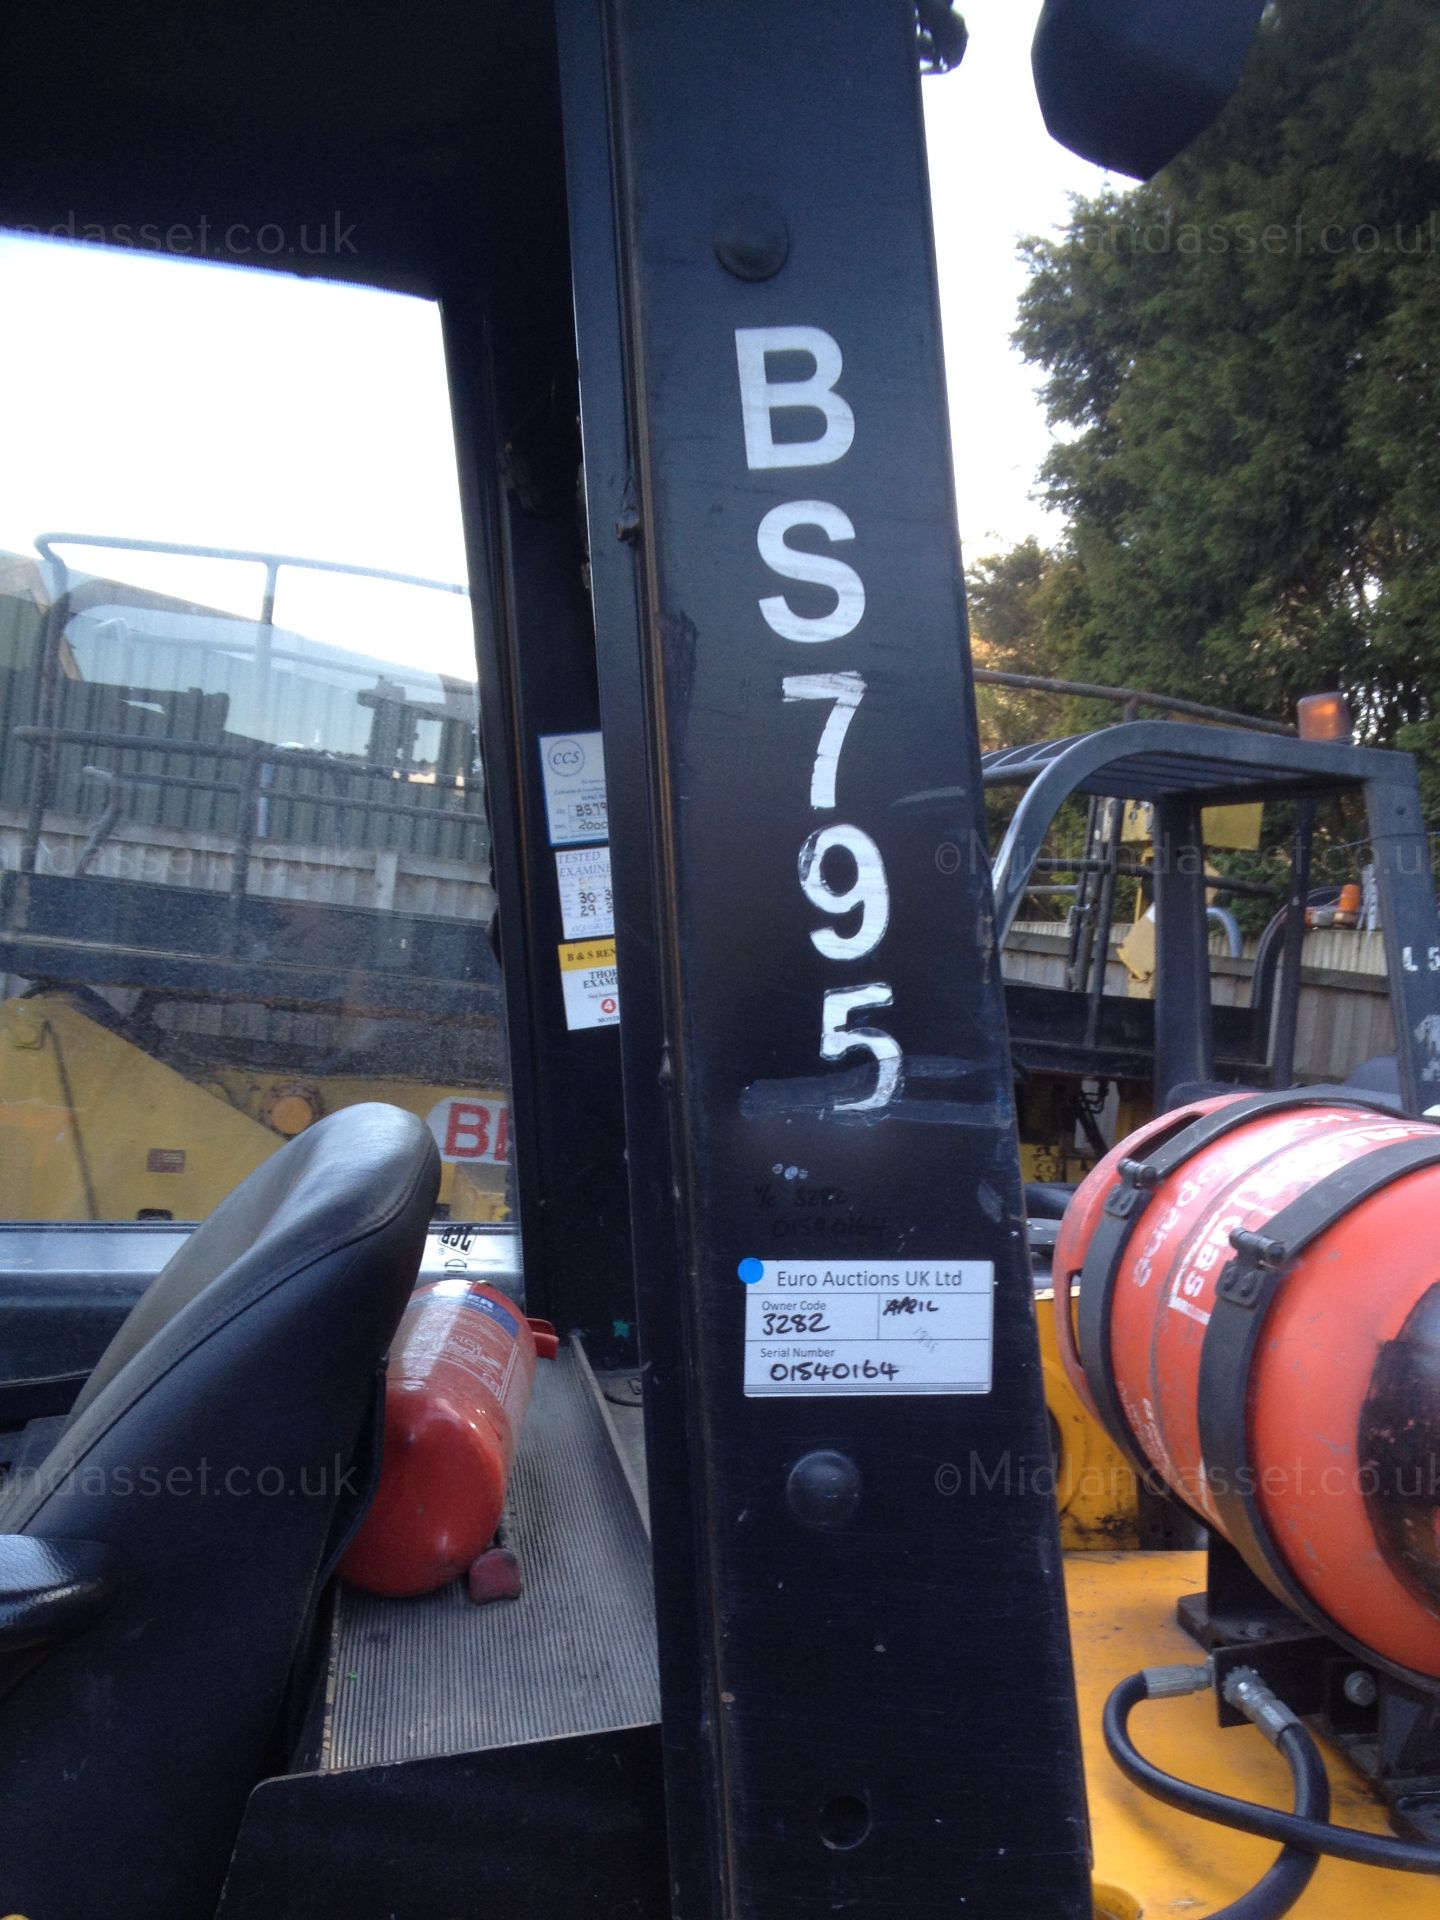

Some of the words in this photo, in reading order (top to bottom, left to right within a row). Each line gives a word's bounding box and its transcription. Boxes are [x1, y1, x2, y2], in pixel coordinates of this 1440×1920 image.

[553, 750, 580, 765] CCS
[558, 851, 600, 864] TESTED
[604, 1000, 614, 1011] 4
[777, 1270, 817, 1287] Euro
[822, 1270, 900, 1287] Auctions
[905, 1270, 930, 1287] UK
[936, 1269, 962, 1287] Ltd
[762, 1300, 798, 1311] Owner
[800, 1300, 827, 1311] Code
[762, 1312, 831, 1336] 3282
[760, 1347, 790, 1358] Serial
[792, 1347, 836, 1358] Number
[769, 1359, 900, 1382] 01540164
